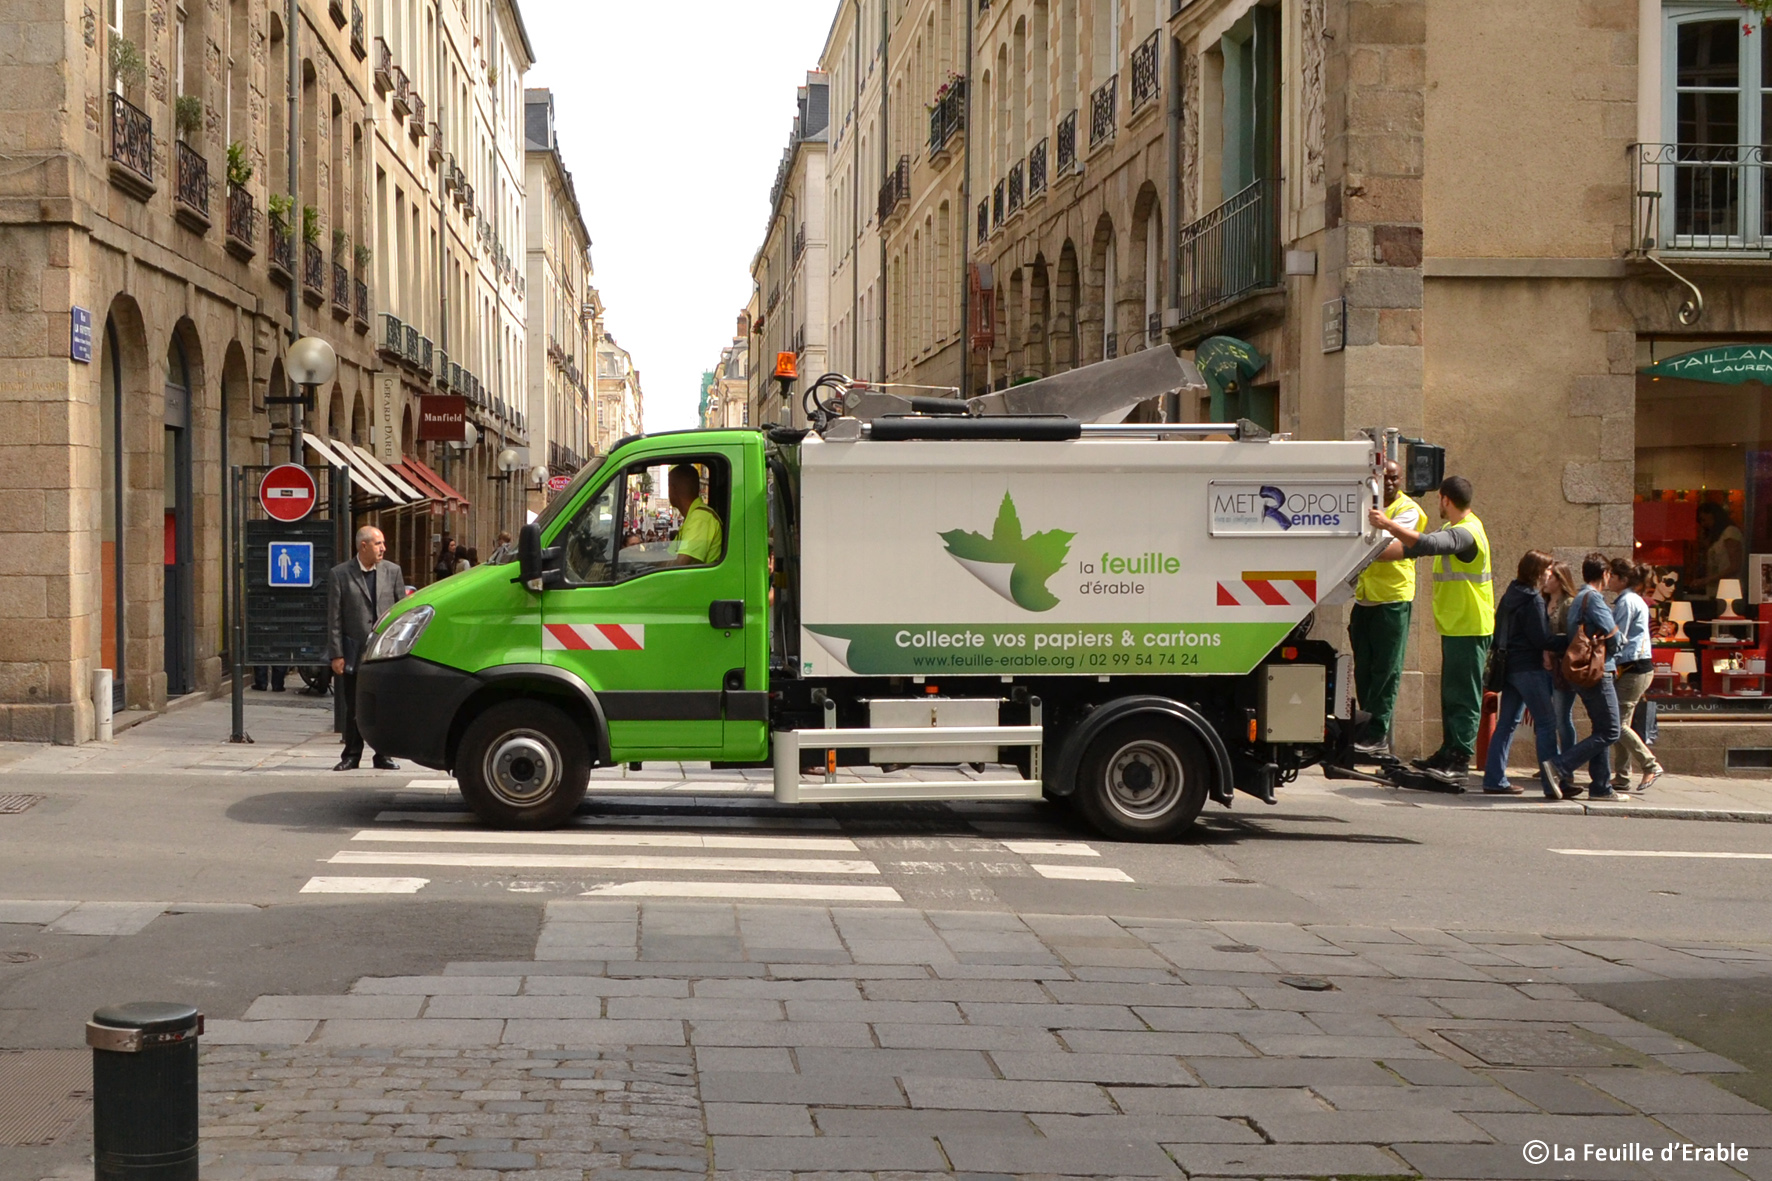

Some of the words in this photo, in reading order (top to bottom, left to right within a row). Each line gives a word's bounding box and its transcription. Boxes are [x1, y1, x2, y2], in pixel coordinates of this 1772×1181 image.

[424, 413, 462, 422] Manfield
[1080, 561, 1094, 574] la
[1101, 552, 1180, 574] feuille
[1079, 580, 1145, 594] d'érable
[895, 630, 985, 648] Collecte
[993, 633, 1026, 647] vos
[1034, 630, 1113, 650] papiers
[1121, 629, 1135, 647] &
[1143, 630, 1221, 647] cartons
[913, 654, 1075, 669] www.feuille-erable.org
[1079, 654, 1085, 667] /
[1089, 653, 1107, 666] 02
[1112, 654, 1130, 666] 99
[1135, 654, 1153, 666] 54
[1159, 654, 1176, 666] 74
[1181, 654, 1198, 666] 24
